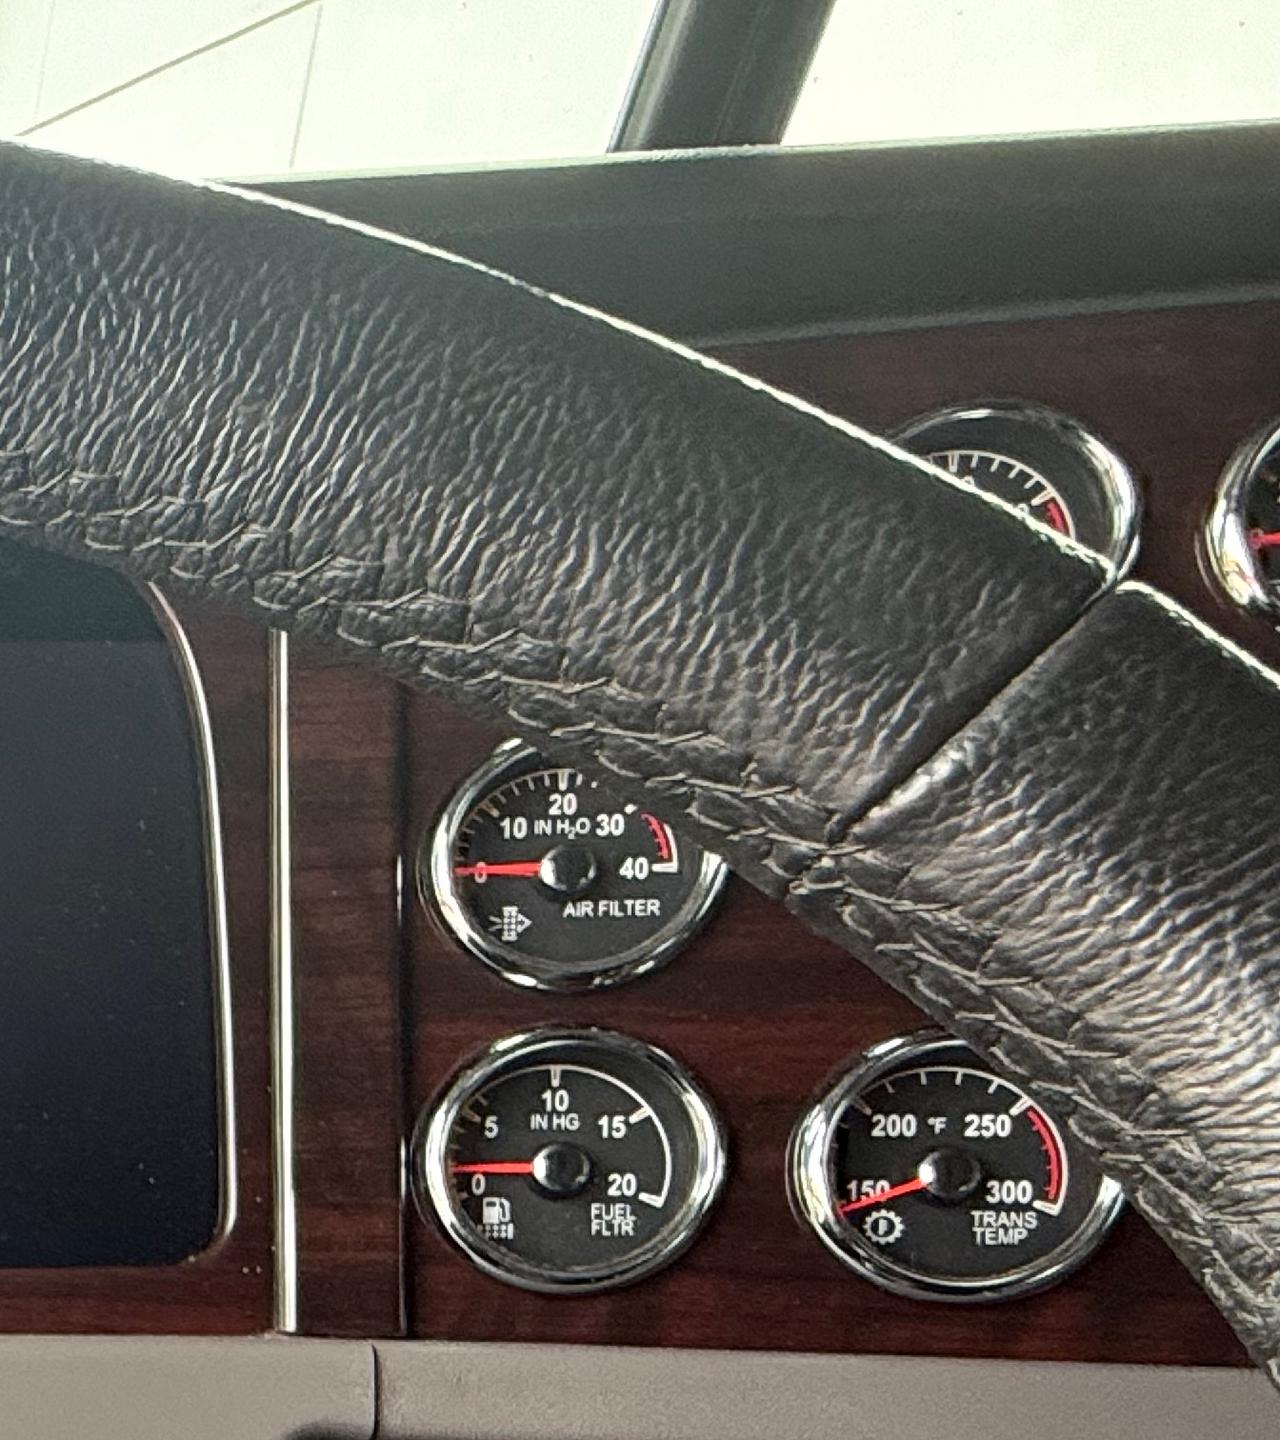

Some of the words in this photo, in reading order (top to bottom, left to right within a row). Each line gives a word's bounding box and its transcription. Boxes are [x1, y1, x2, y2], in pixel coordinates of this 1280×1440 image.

[548, 792, 578, 817] 20
[500, 816, 528, 840] 10
[533, 818, 553, 837] IN
[595, 813, 625, 837] 30
[618, 856, 651, 881] 40
[562, 900, 596, 919] AIR
[598, 898, 662, 918] FILTER
[541, 1089, 570, 1113] 10
[483, 1115, 500, 1139] 5
[529, 1113, 549, 1131] IN
[552, 1113, 581, 1132] HG
[597, 1115, 627, 1139] 15
[870, 1113, 918, 1138] 200
[963, 1113, 1012, 1138] 250
[471, 1174, 486, 1196] 0
[607, 1173, 638, 1197] 20
[986, 1179, 1034, 1204] 300
[590, 1202, 637, 1221] FUEL
[971, 1210, 1038, 1229] TRANS
[590, 1220, 635, 1237] FLTR
[973, 1227, 1029, 1246] TEMP
